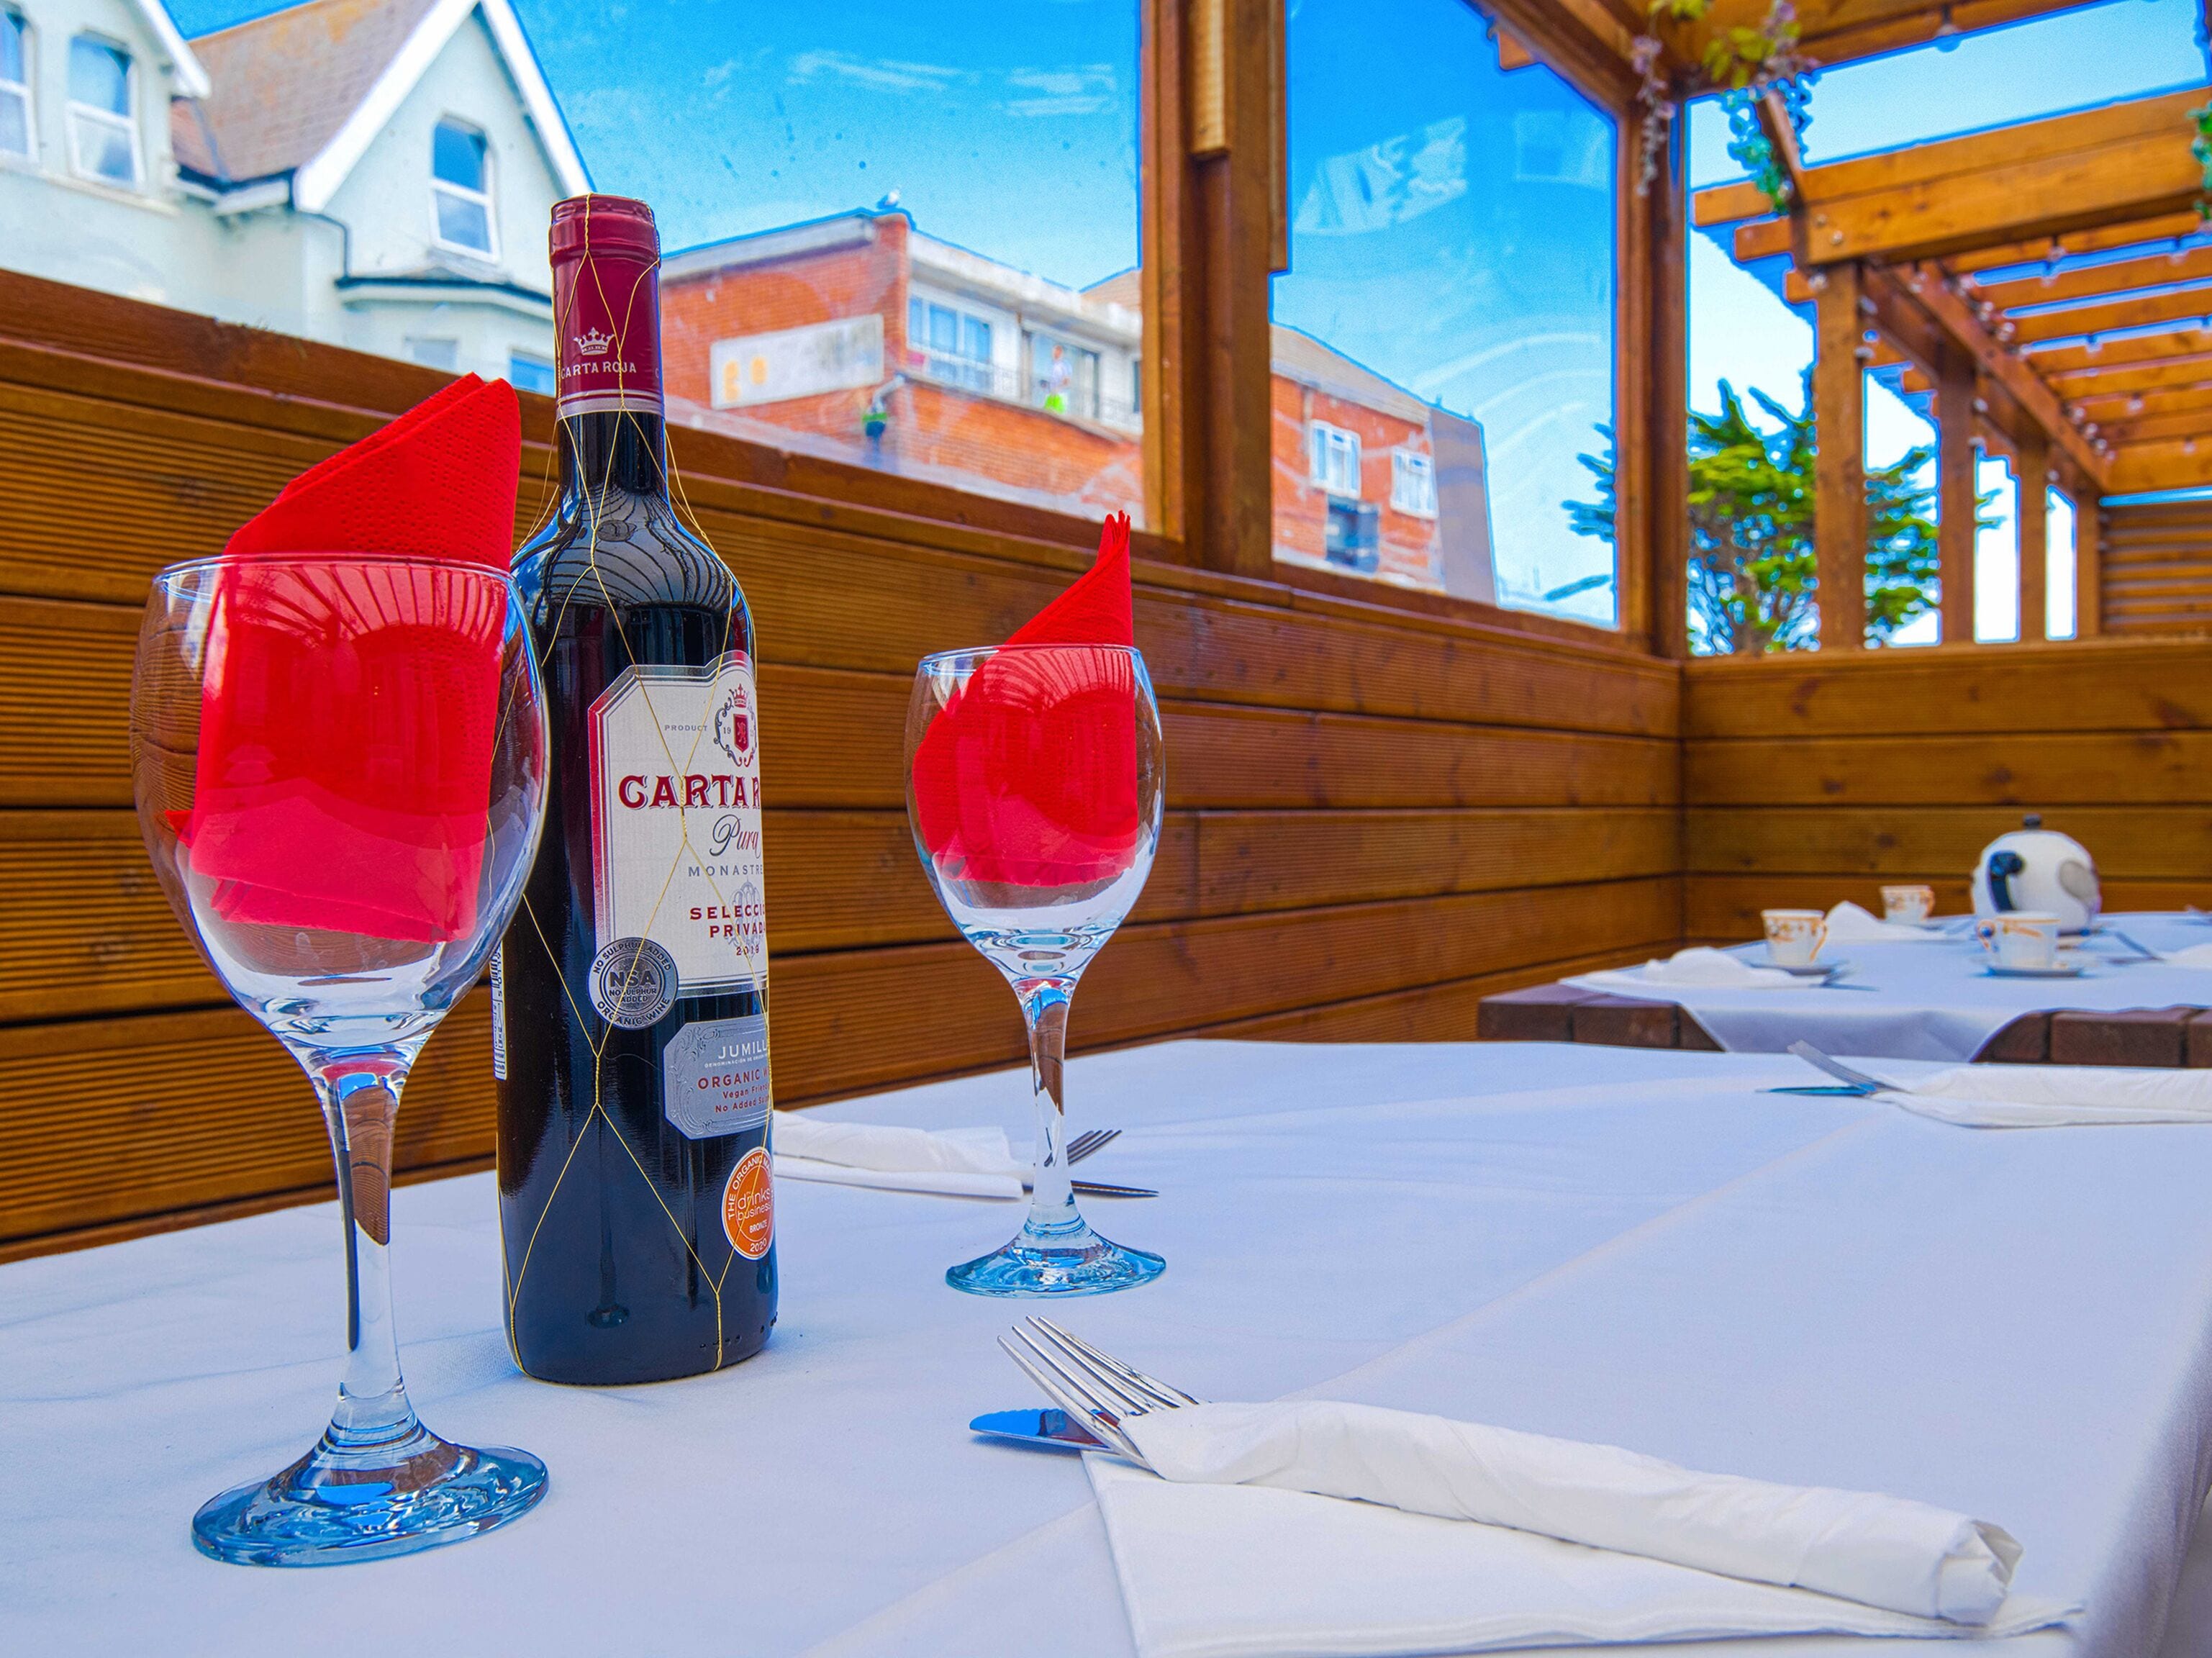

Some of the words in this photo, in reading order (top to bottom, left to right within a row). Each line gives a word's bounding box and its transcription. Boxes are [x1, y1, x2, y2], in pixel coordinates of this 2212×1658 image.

[561, 362, 599, 379] CARTA
[603, 361, 637, 373] ROJA
[619, 774, 749, 810] CARTA
[593, 960, 604, 974] NO
[647, 946, 671, 971] ADDED
[609, 970, 656, 987] NSA
[597, 1001, 643, 1025] ORGANIC
[645, 997, 670, 1021] WINE
[697, 1069, 760, 1090] ORGANIC
[722, 1088, 748, 1100] Vegan
[715, 1105, 728, 1113] No
[733, 1097, 756, 1110] Added
[727, 1194, 736, 1221] THE
[738, 1187, 771, 1210] drinks
[750, 1238, 768, 1252] 2020
